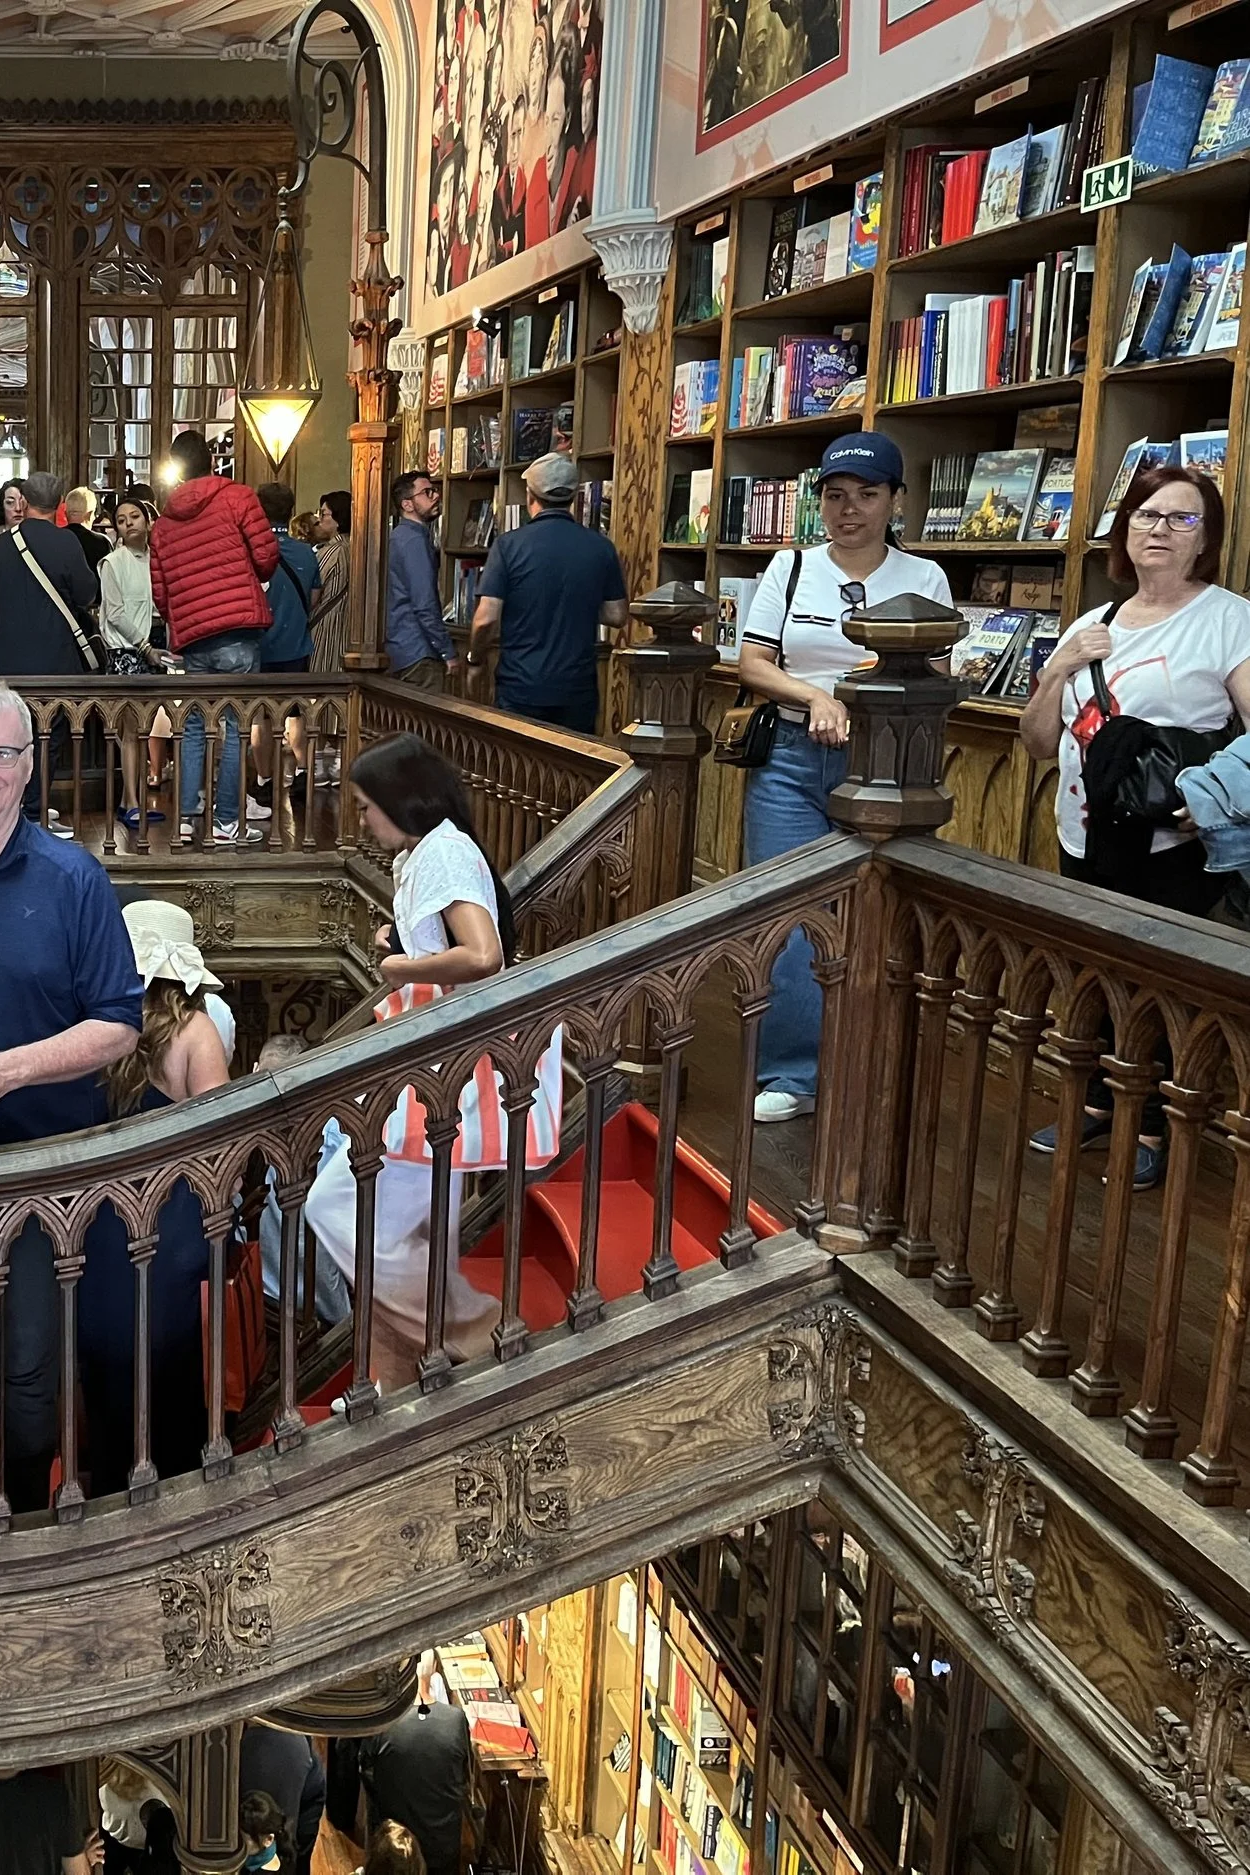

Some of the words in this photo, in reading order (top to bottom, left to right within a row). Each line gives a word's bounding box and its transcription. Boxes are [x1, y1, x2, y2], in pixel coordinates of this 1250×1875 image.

[830, 449, 853, 460] Calvin
[854, 447, 875, 457] Klein
[977, 634, 1007, 645] PORTO
